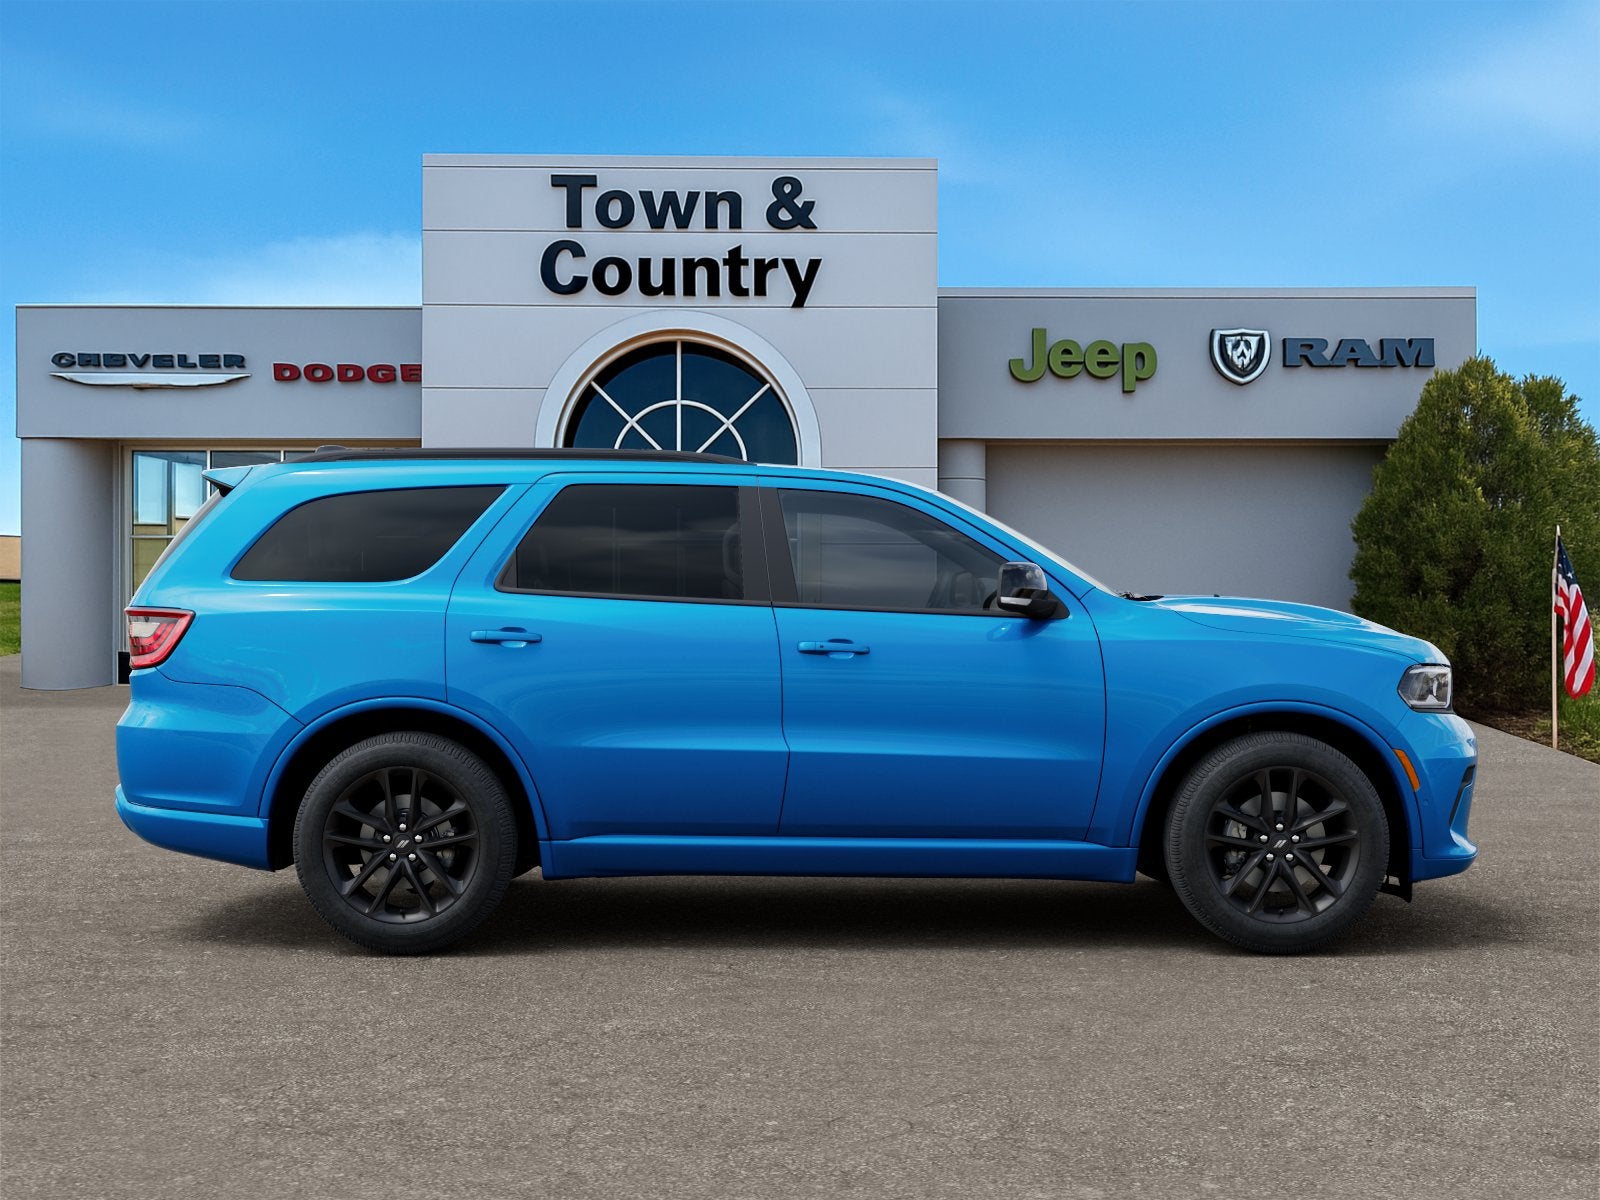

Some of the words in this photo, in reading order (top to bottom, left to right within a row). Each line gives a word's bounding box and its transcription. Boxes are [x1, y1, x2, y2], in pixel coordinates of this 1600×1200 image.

[551, 174, 742, 229] Town
[765, 176, 818, 230] &
[540, 239, 822, 308] Country
[273, 363, 422, 383] DODGE
[1009, 328, 1157, 392] Jeep
[1282, 338, 1435, 368] RAM
